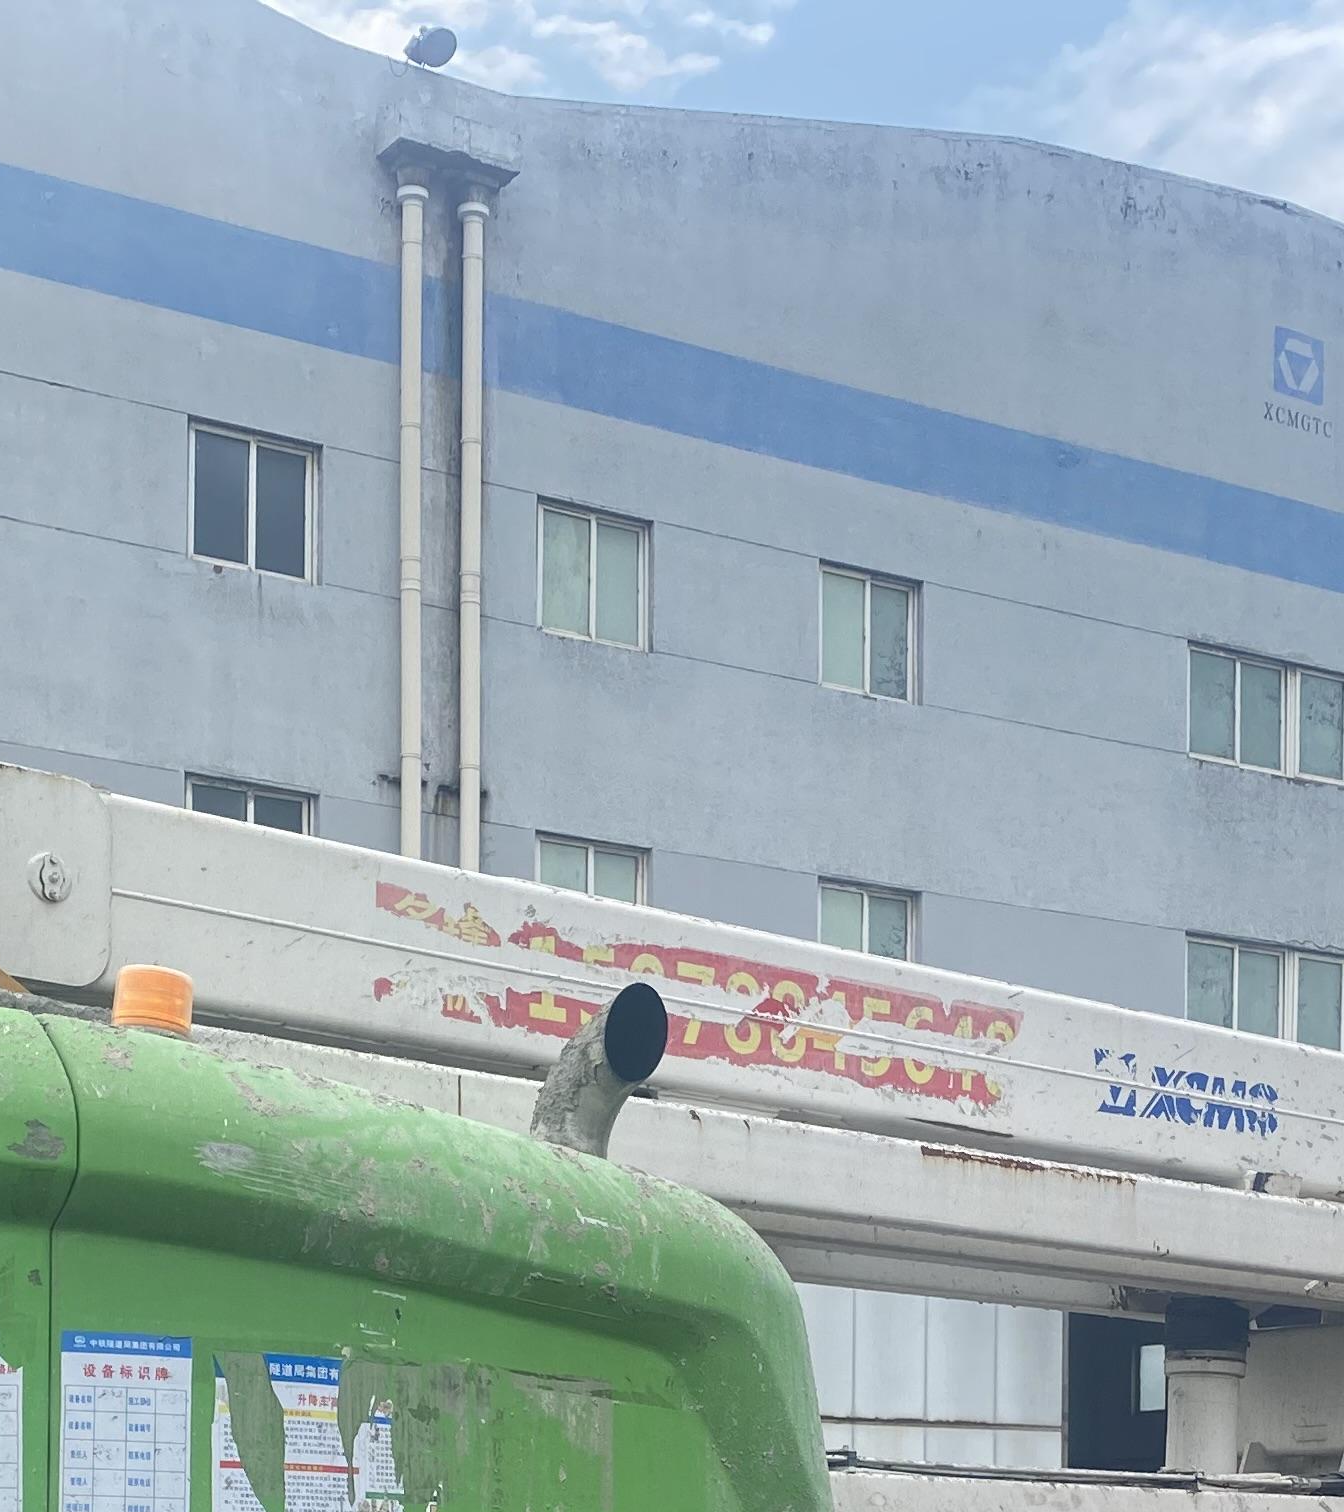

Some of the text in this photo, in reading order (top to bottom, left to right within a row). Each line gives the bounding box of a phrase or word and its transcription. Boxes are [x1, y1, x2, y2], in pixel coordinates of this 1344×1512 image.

[1263, 402, 1333, 439] XCMGTC
[89, 1338, 181, 1352] 中铁隧道局集团有限公司
[82, 1363, 173, 1382] 设备标识牌
